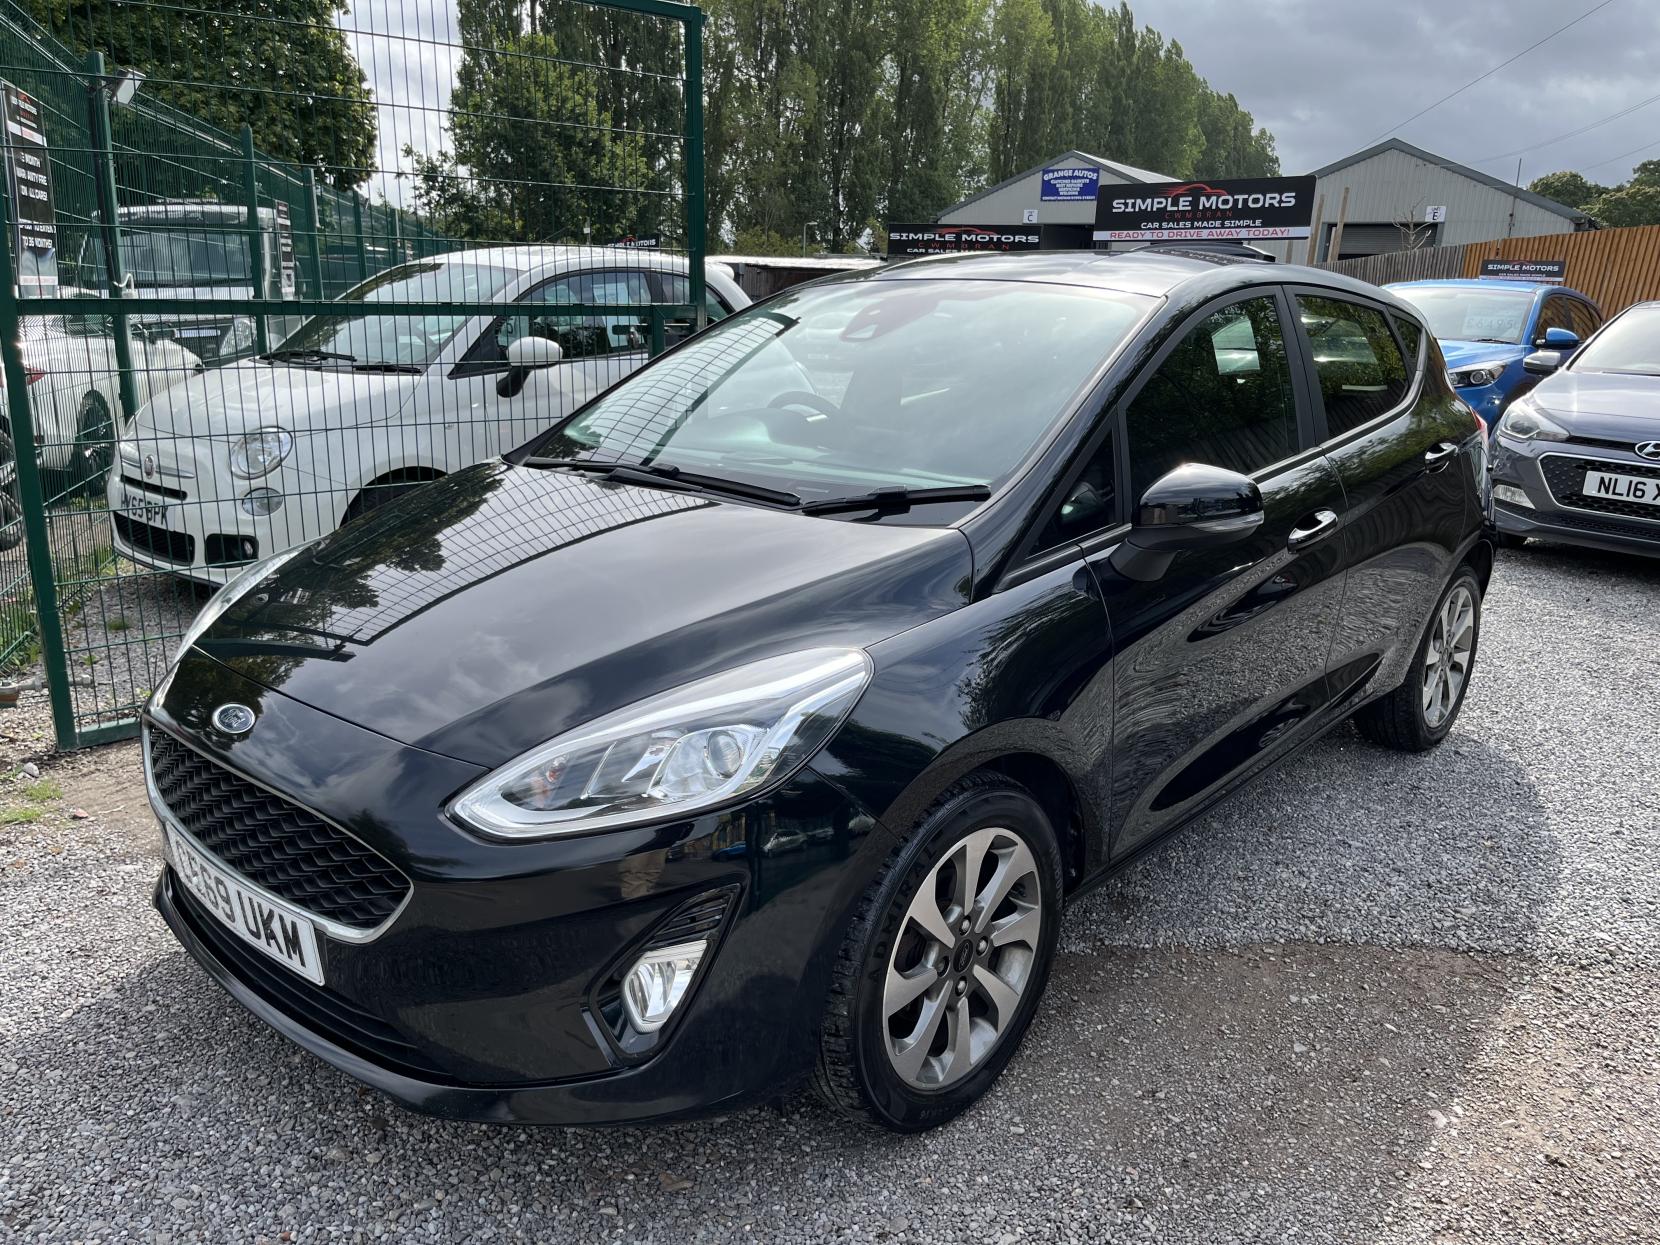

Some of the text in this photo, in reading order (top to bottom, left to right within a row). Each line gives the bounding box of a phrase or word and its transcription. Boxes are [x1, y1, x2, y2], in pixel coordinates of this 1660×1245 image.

[1043, 169, 1098, 181] GRANGE AUTOS
[1112, 192, 1296, 213] SIMPLE MOTORS
[1028, 214, 1033, 222] C
[1165, 211, 1233, 219] CWMBRAN
[1432, 211, 1439, 221] E
[1162, 221, 1191, 229] SALES
[1224, 220, 1262, 228] SIMPLE
[890, 232, 1040, 243] SIMPLE MOTORS
[1110, 231, 1144, 239] READY
[1207, 230, 1242, 238] AWAY
[1246, 229, 1290, 237] TODAY!
[1597, 476, 1647, 499] NL16
[236, 889, 307, 969] UKM
